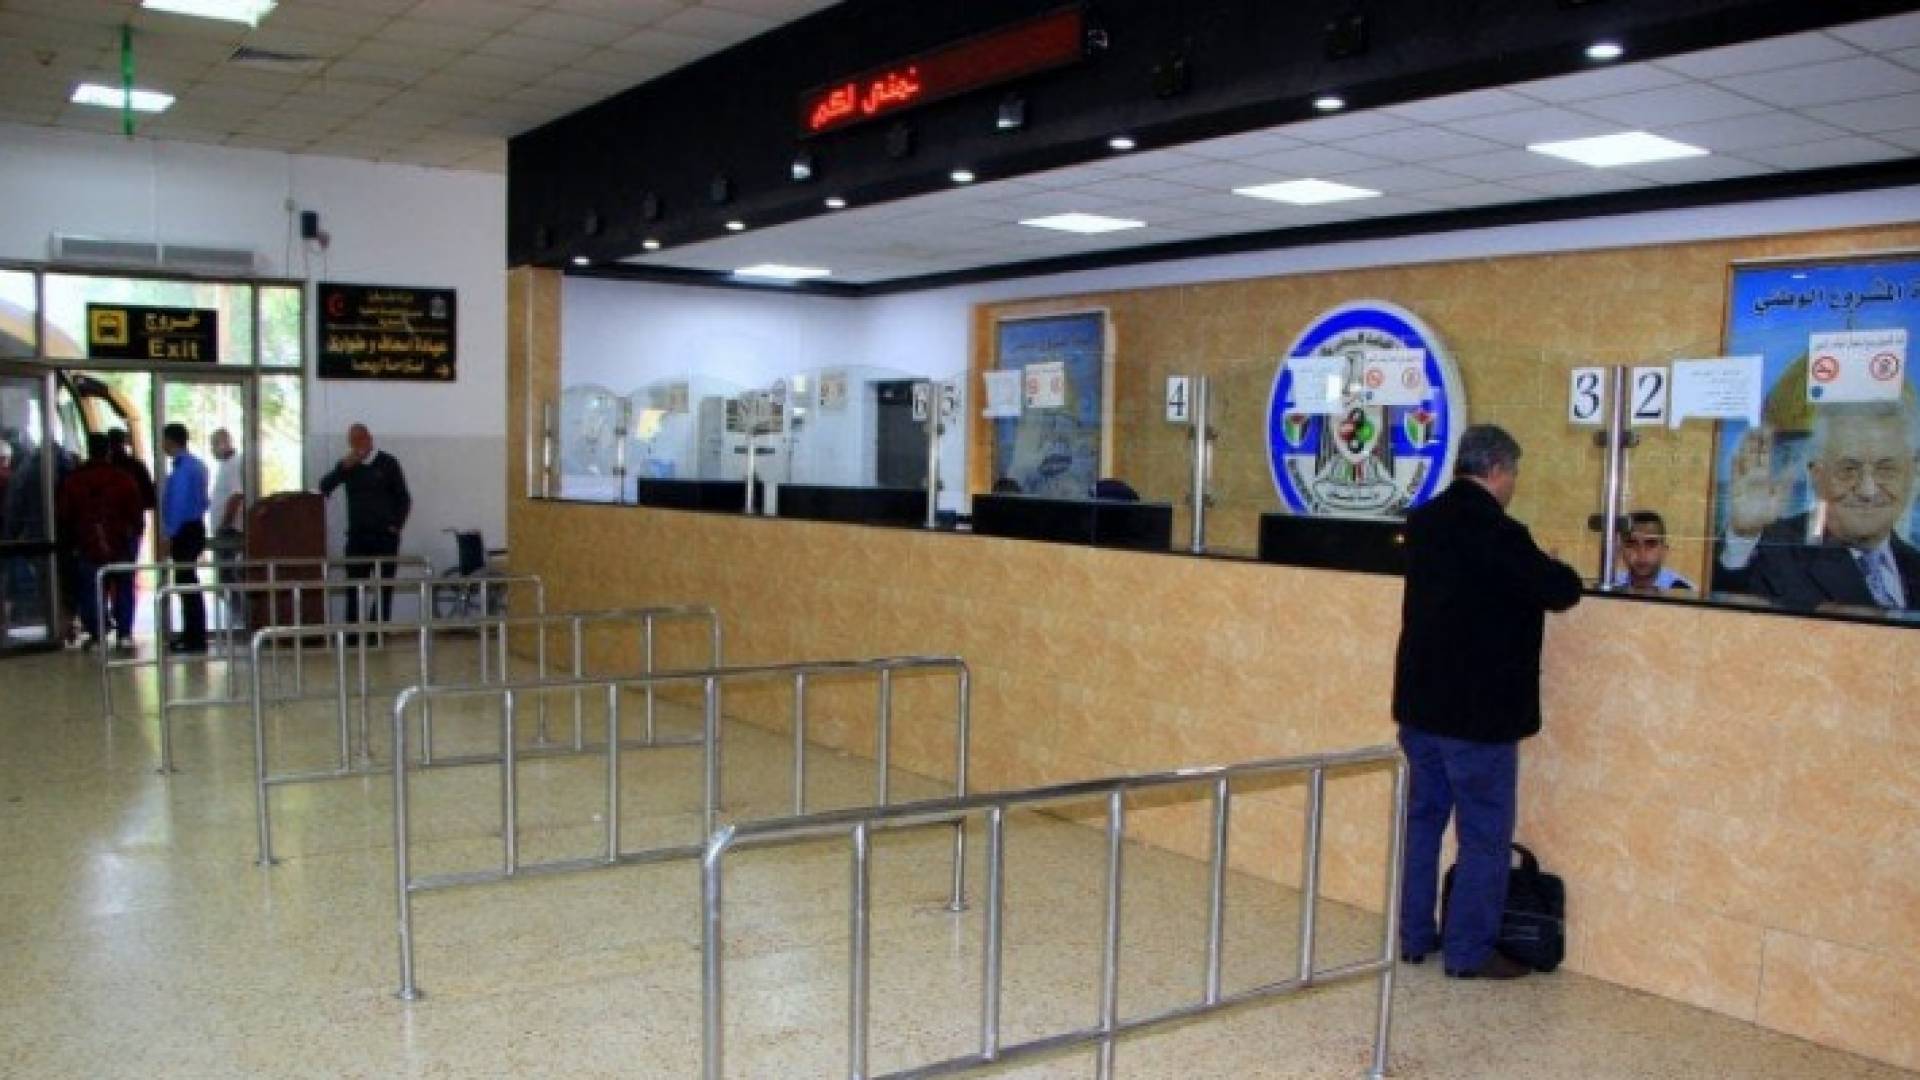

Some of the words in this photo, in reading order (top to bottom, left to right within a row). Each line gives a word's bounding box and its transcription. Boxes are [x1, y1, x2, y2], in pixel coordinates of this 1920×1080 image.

[1830, 279, 1903, 314] المشروع
[145, 309, 201, 333] خروج
[147, 338, 199, 360] Exit
[1168, 382, 1185, 417] 4
[1573, 371, 1600, 419] 3
[1633, 371, 1664, 419] 2
